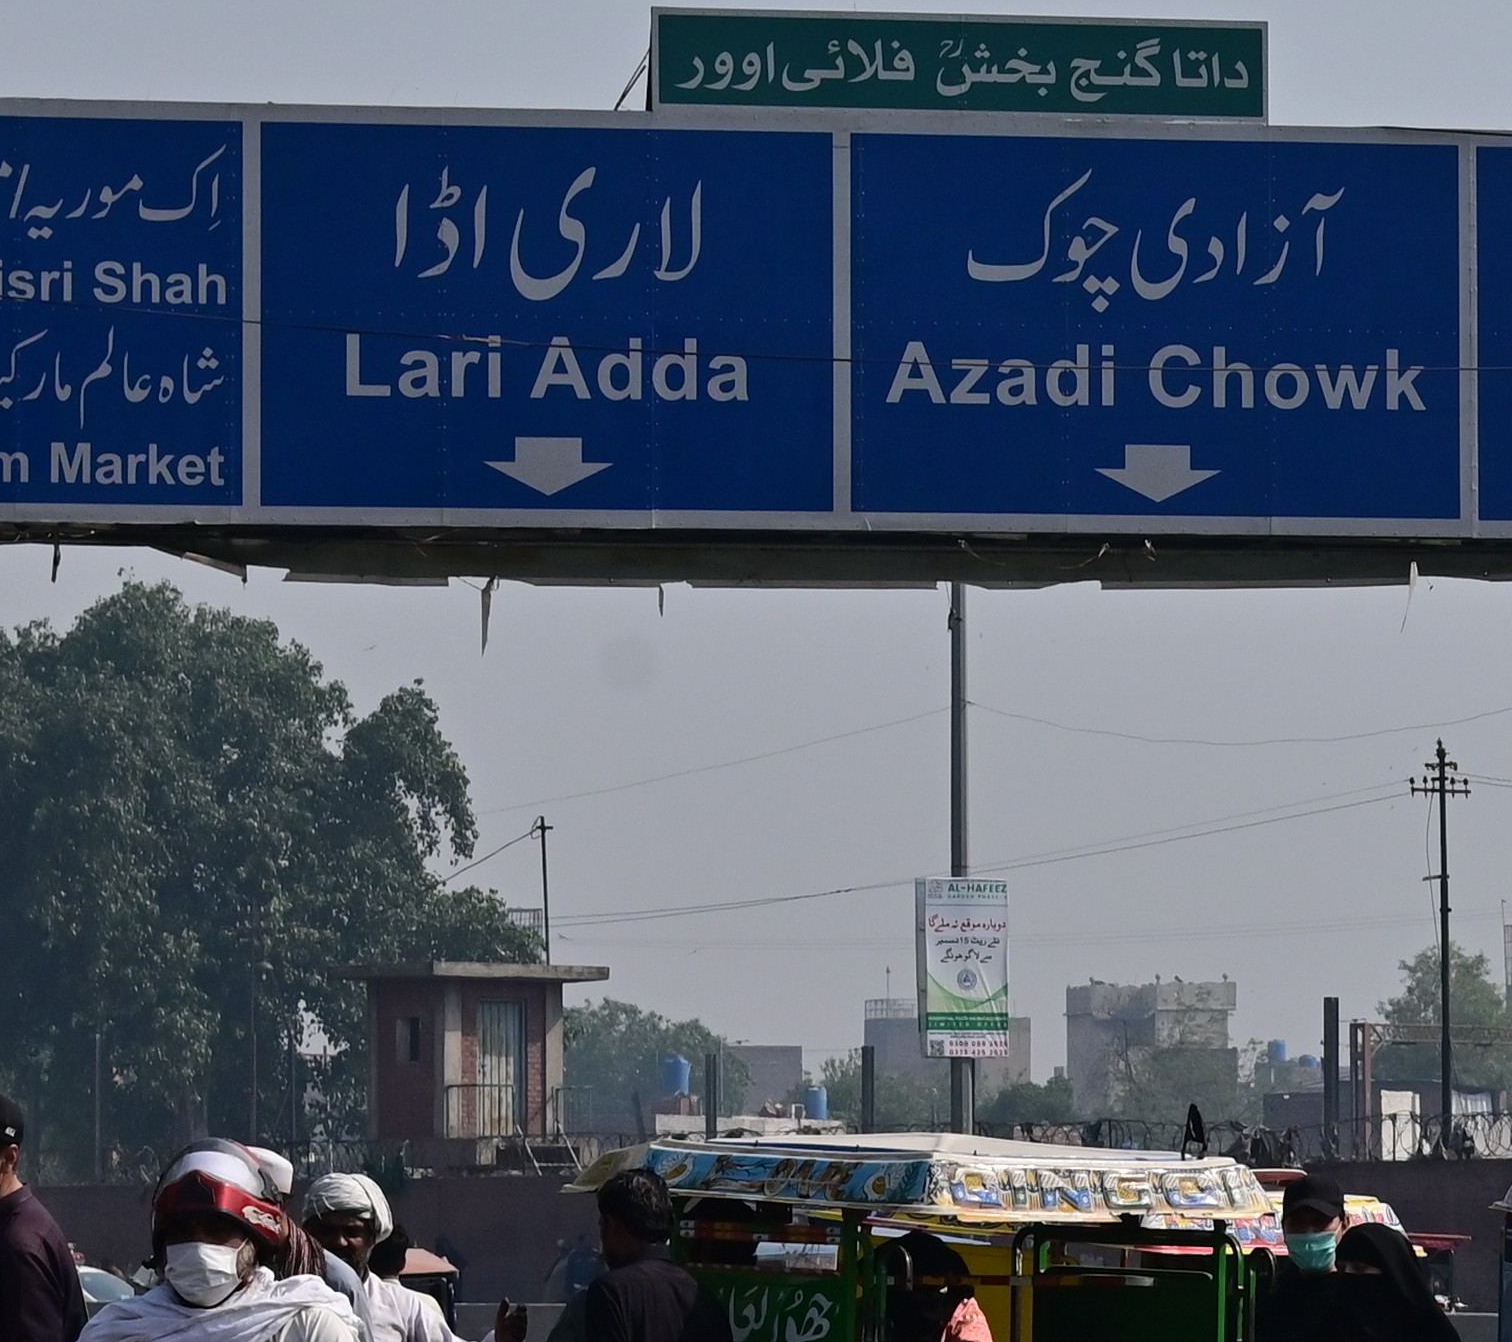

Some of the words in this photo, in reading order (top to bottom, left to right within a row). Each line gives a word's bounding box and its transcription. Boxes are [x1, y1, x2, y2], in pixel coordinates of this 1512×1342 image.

[675, 41, 776, 89] اوور
[1070, 39, 1162, 101] گنج
[1173, 54, 1250, 90] داتا
[396, 166, 486, 279] اڈا
[511, 165, 703, 300] لاری
[966, 169, 1120, 312] چوک
[1131, 186, 1345, 300] آزادی
[94, 260, 226, 304] Shah
[81, 327, 150, 428] عالم
[159, 347, 224, 404] شاہ
[346, 334, 505, 399] Lari
[531, 337, 748, 403] Adda
[887, 341, 1116, 407] Azadi
[1148, 347, 1426, 411] Chowk
[51, 444, 224, 486] Market
[948, 883, 1007, 893] AL-HAFEEZ
